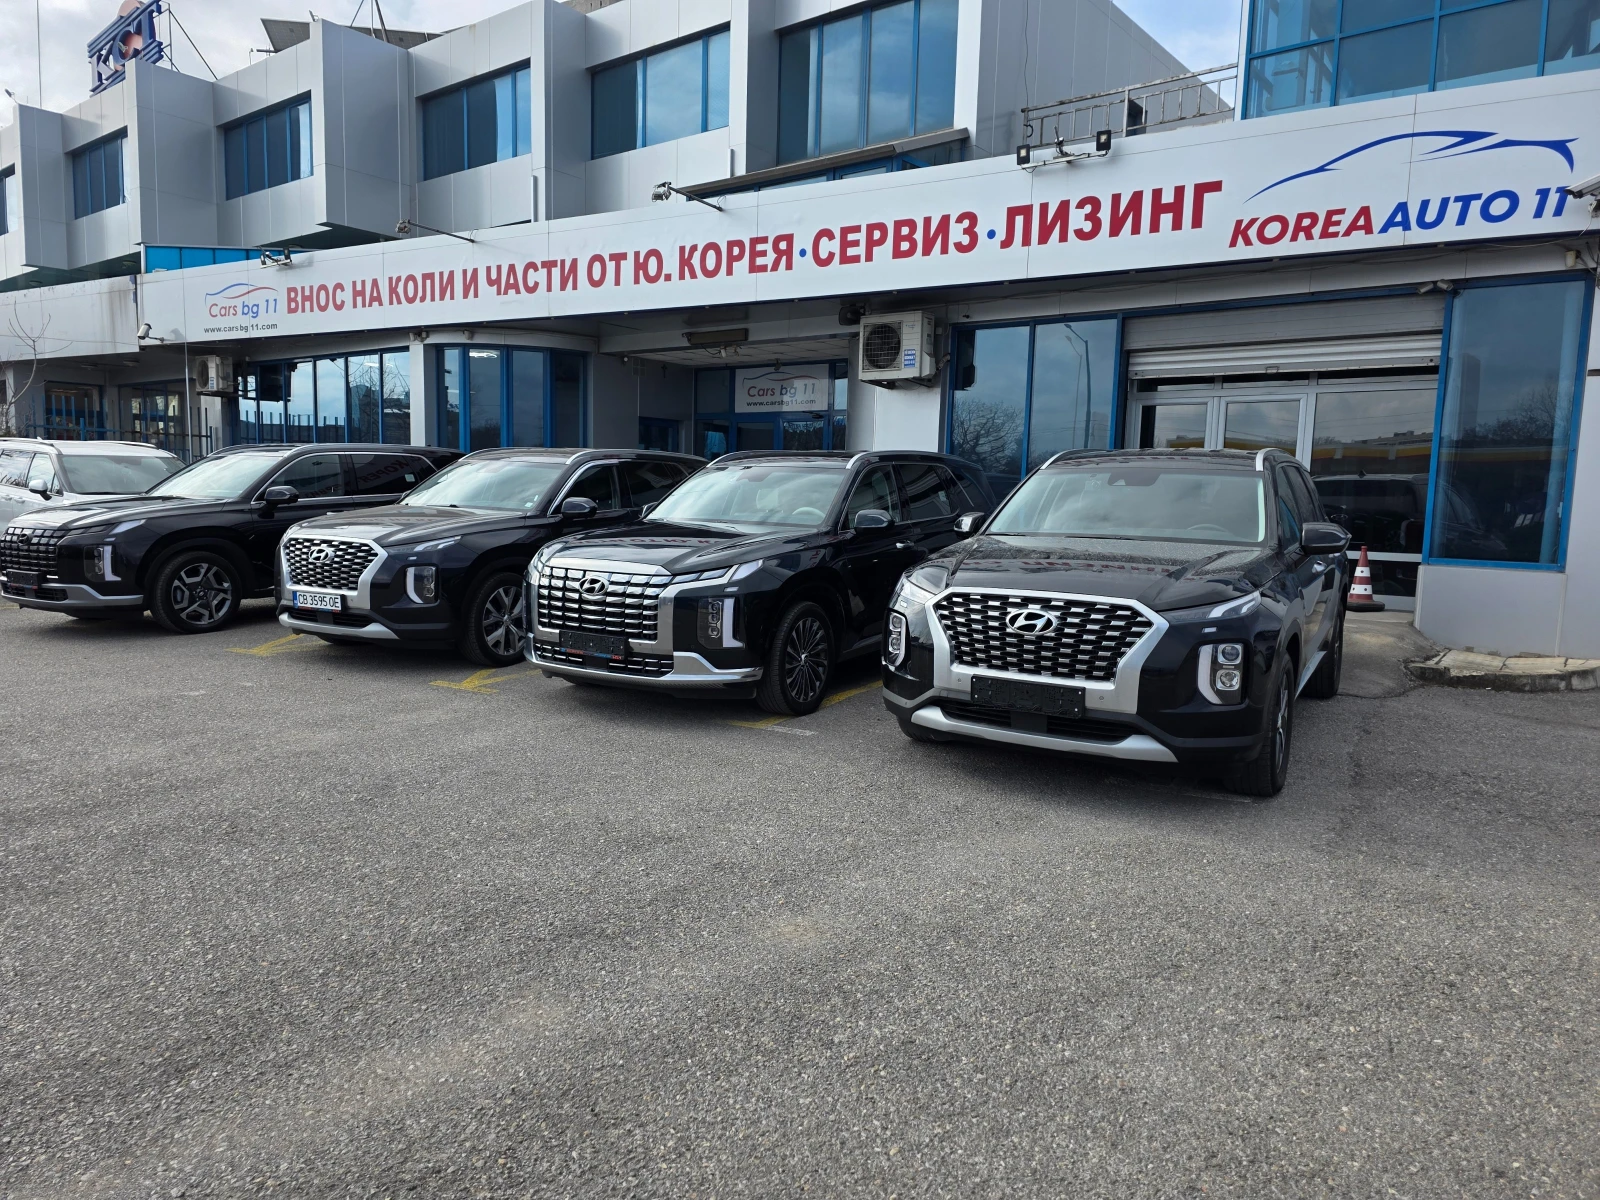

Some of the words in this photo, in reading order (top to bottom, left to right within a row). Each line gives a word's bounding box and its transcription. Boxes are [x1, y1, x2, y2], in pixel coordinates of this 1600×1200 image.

[1228, 205, 1374, 249] KOREA
[1377, 188, 1521, 235] AUTO
[1532, 185, 1571, 220] 11
[286, 283, 345, 315] ВНОС
[351, 278, 384, 309] НА
[388, 270, 456, 306] КОЛИ
[461, 268, 479, 299] И
[485, 257, 578, 296] ЧАСТИ
[586, 251, 628, 288] ОТ
[632, 248, 672, 285] Ю.
[677, 233, 795, 282] КОРЕЯ
[810, 211, 980, 269] СЕРВИЗ
[999, 179, 1224, 250] ЛИЗИНГ
[209, 303, 238, 318] Cars
[241, 301, 260, 319] bg
[265, 298, 278, 314] 11
[747, 385, 776, 398] Cars
[779, 384, 798, 399] bg
[803, 382, 816, 395] 11
[746, 399, 816, 407] www.carsbg11.com
[298, 593, 308, 605] CB
[309, 595, 327, 607] 3595
